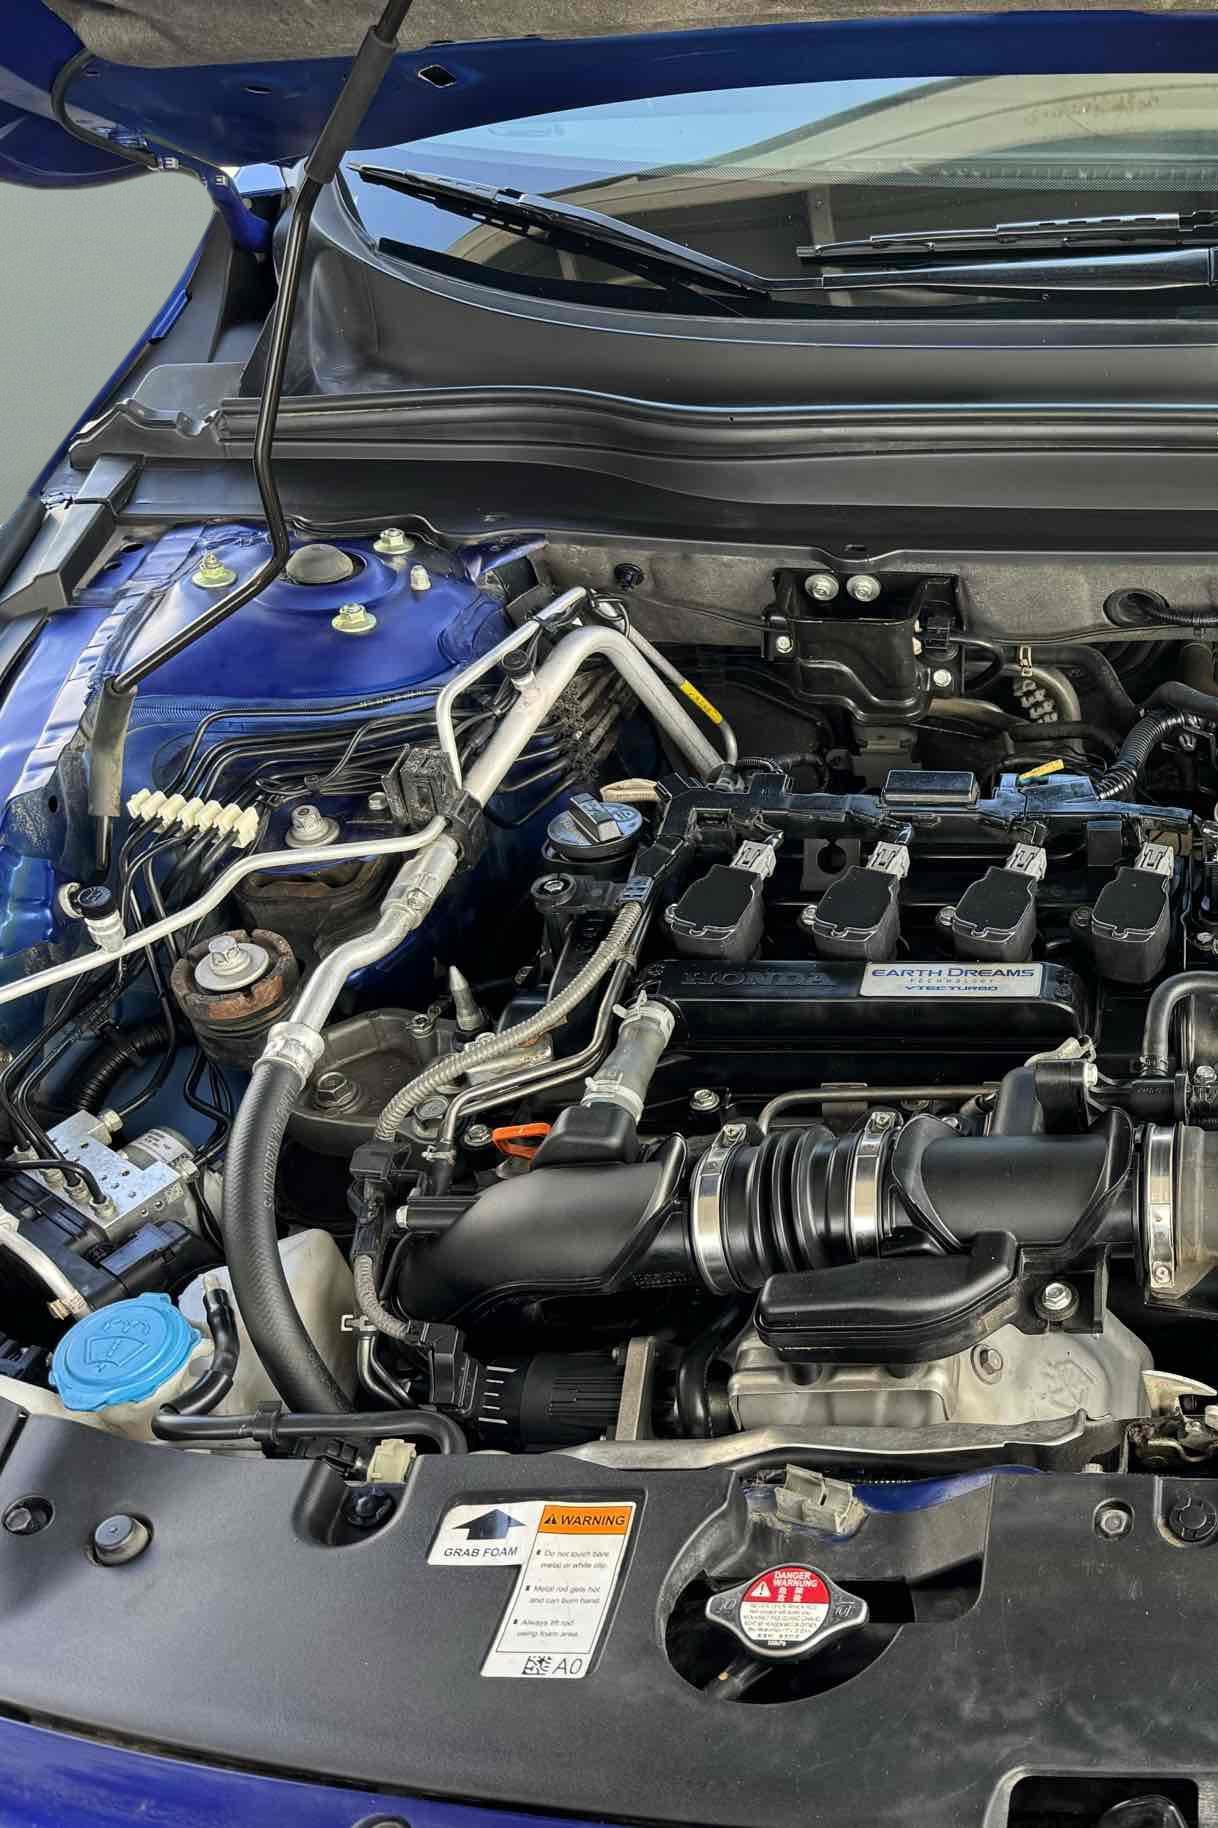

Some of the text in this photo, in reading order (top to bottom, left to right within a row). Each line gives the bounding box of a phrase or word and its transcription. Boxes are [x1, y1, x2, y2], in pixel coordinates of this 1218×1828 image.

[871, 968, 943, 977] EARTH
[561, 1514, 625, 1526] WARNING
[443, 1546, 518, 1557] GRAB FOAM
[551, 1657, 583, 1675] A0
